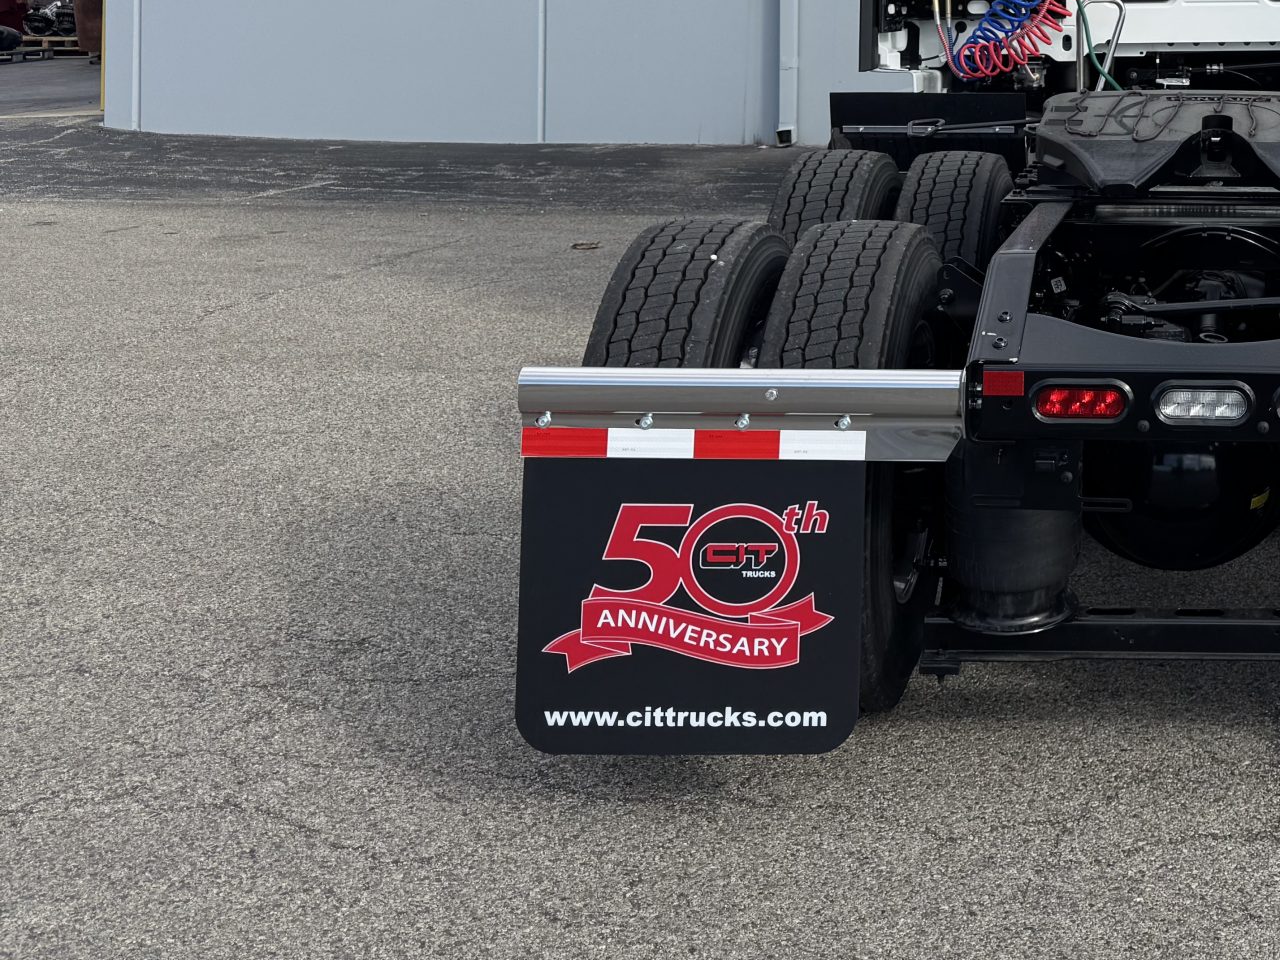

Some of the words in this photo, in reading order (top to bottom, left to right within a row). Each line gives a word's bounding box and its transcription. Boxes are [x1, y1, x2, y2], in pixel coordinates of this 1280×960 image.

[589, 501, 829, 618] 50th
[700, 543, 778, 569] CIT
[741, 570, 776, 578] TRUCKS
[597, 609, 788, 657] ANNIVERSARY
[544, 706, 828, 728] www.cittrucks.com
